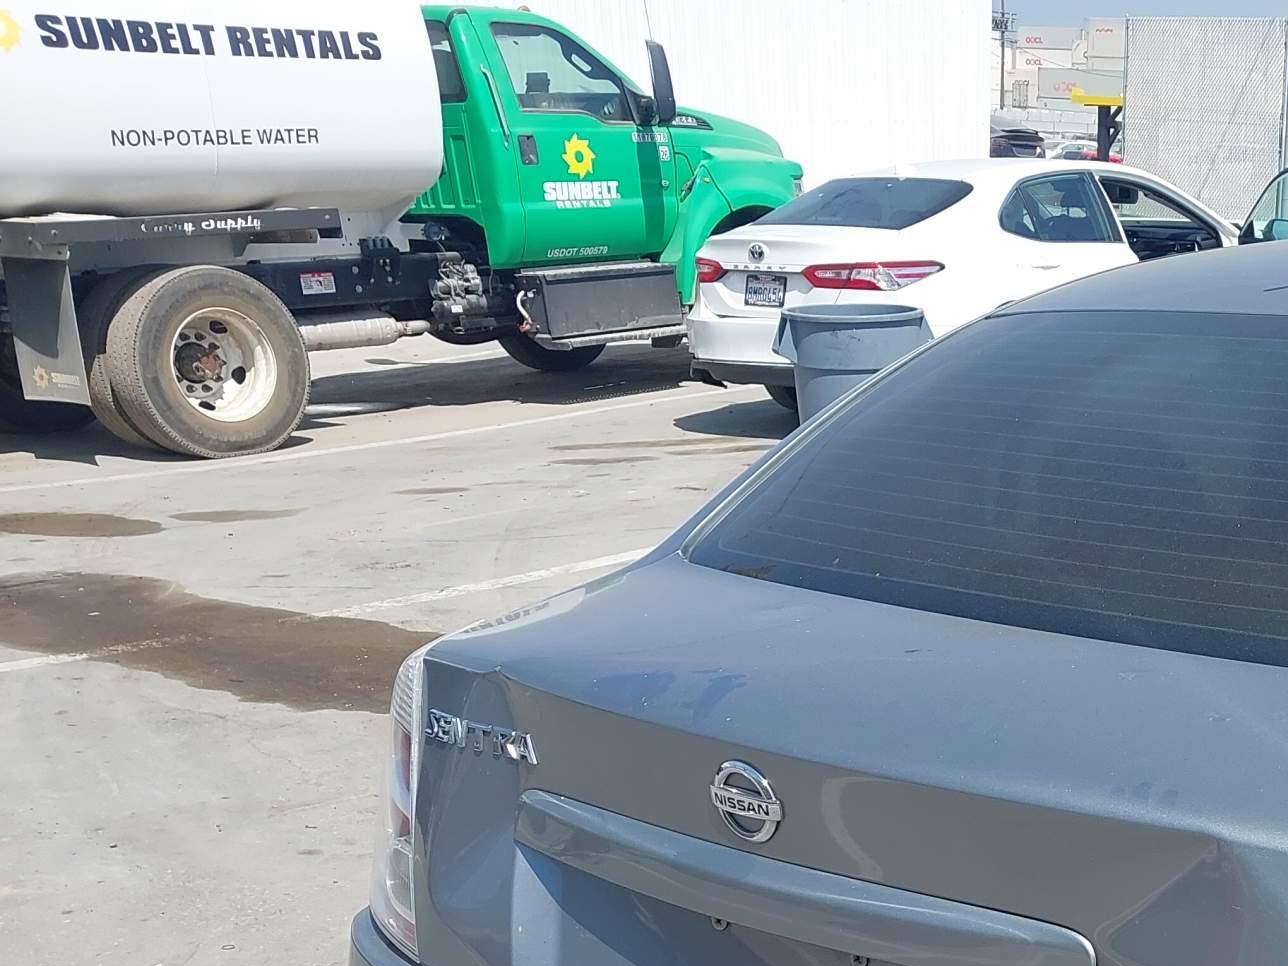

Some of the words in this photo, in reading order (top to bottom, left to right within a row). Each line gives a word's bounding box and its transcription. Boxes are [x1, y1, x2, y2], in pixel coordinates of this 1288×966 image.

[34, 14, 216, 56] SUNBELT
[225, 25, 382, 61] RENTALS
[111, 129, 253, 148] NON-POTABLE
[257, 128, 320, 145] WATER
[543, 181, 619, 201] SUNBELT
[556, 200, 612, 209] RENTALS
[547, 247, 579, 258] USDOT
[579, 245, 609, 256] 500579
[424, 708, 540, 766] SENTRA
[713, 792, 770, 817] NISSAN
